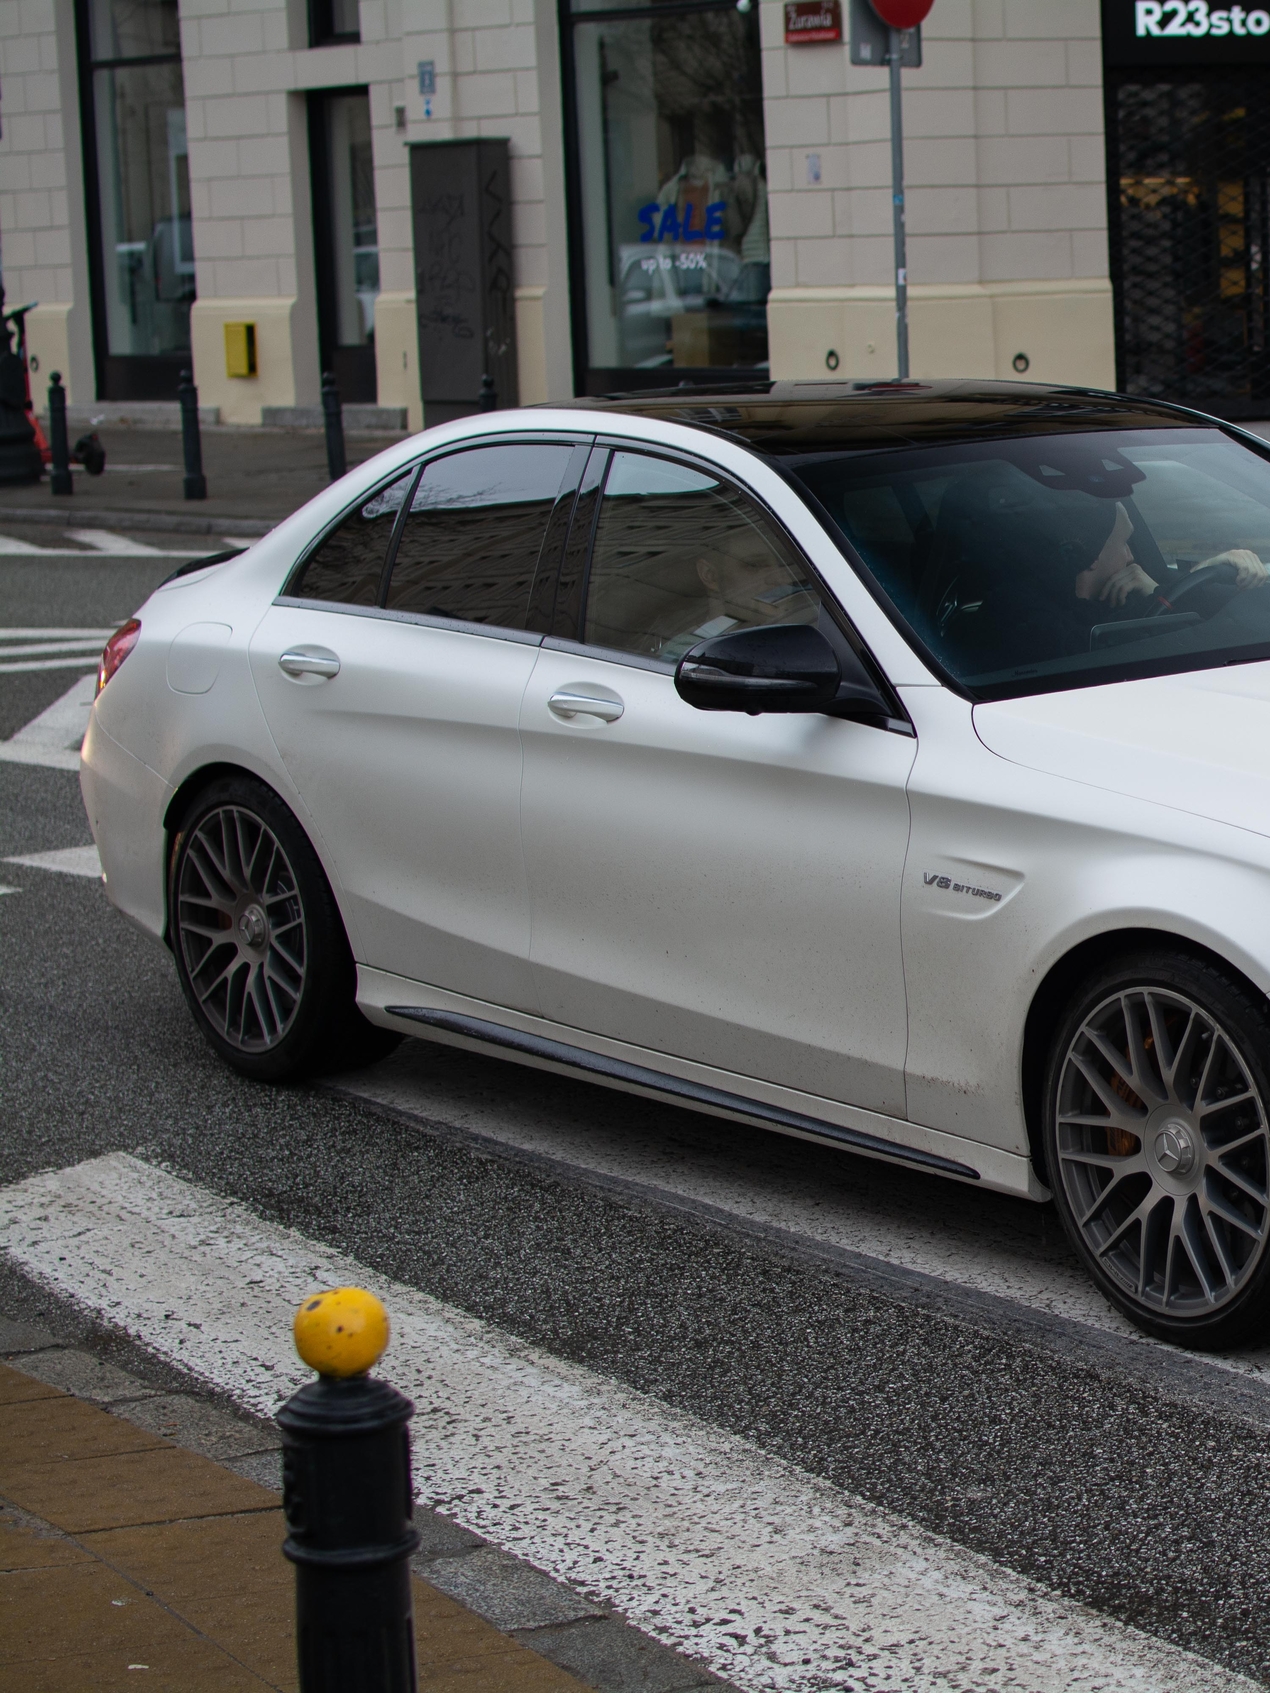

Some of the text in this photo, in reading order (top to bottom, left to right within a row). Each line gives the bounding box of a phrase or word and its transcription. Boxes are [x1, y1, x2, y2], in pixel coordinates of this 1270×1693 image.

[638, 201, 727, 243] SALE
[641, 258, 657, 276] up
[675, 253, 707, 270] -50%
[924, 872, 1002, 901] V8 BITURBO
